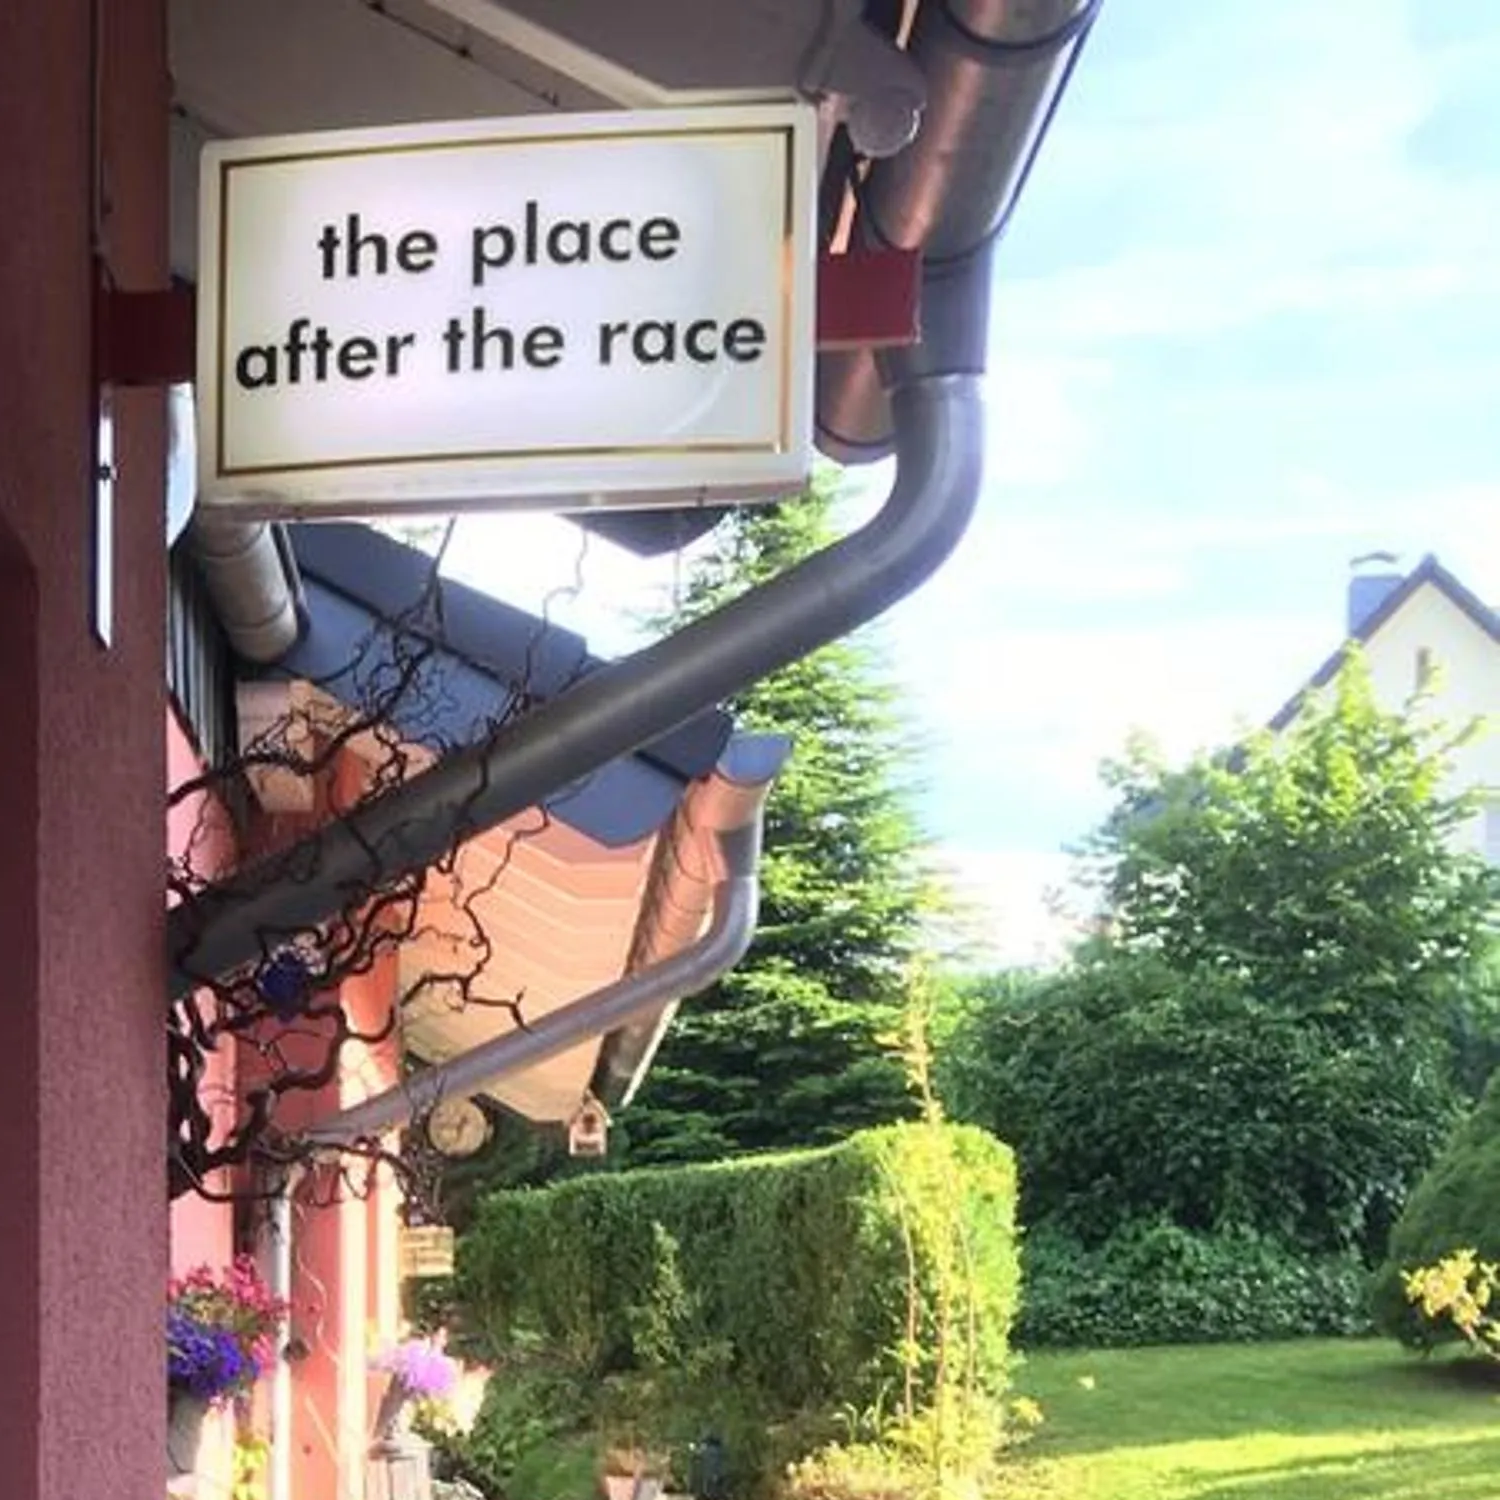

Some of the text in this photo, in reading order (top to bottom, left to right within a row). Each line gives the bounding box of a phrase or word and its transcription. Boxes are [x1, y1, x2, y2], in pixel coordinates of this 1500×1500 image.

[317, 200, 681, 286] the place
[235, 306, 767, 391] after the race
